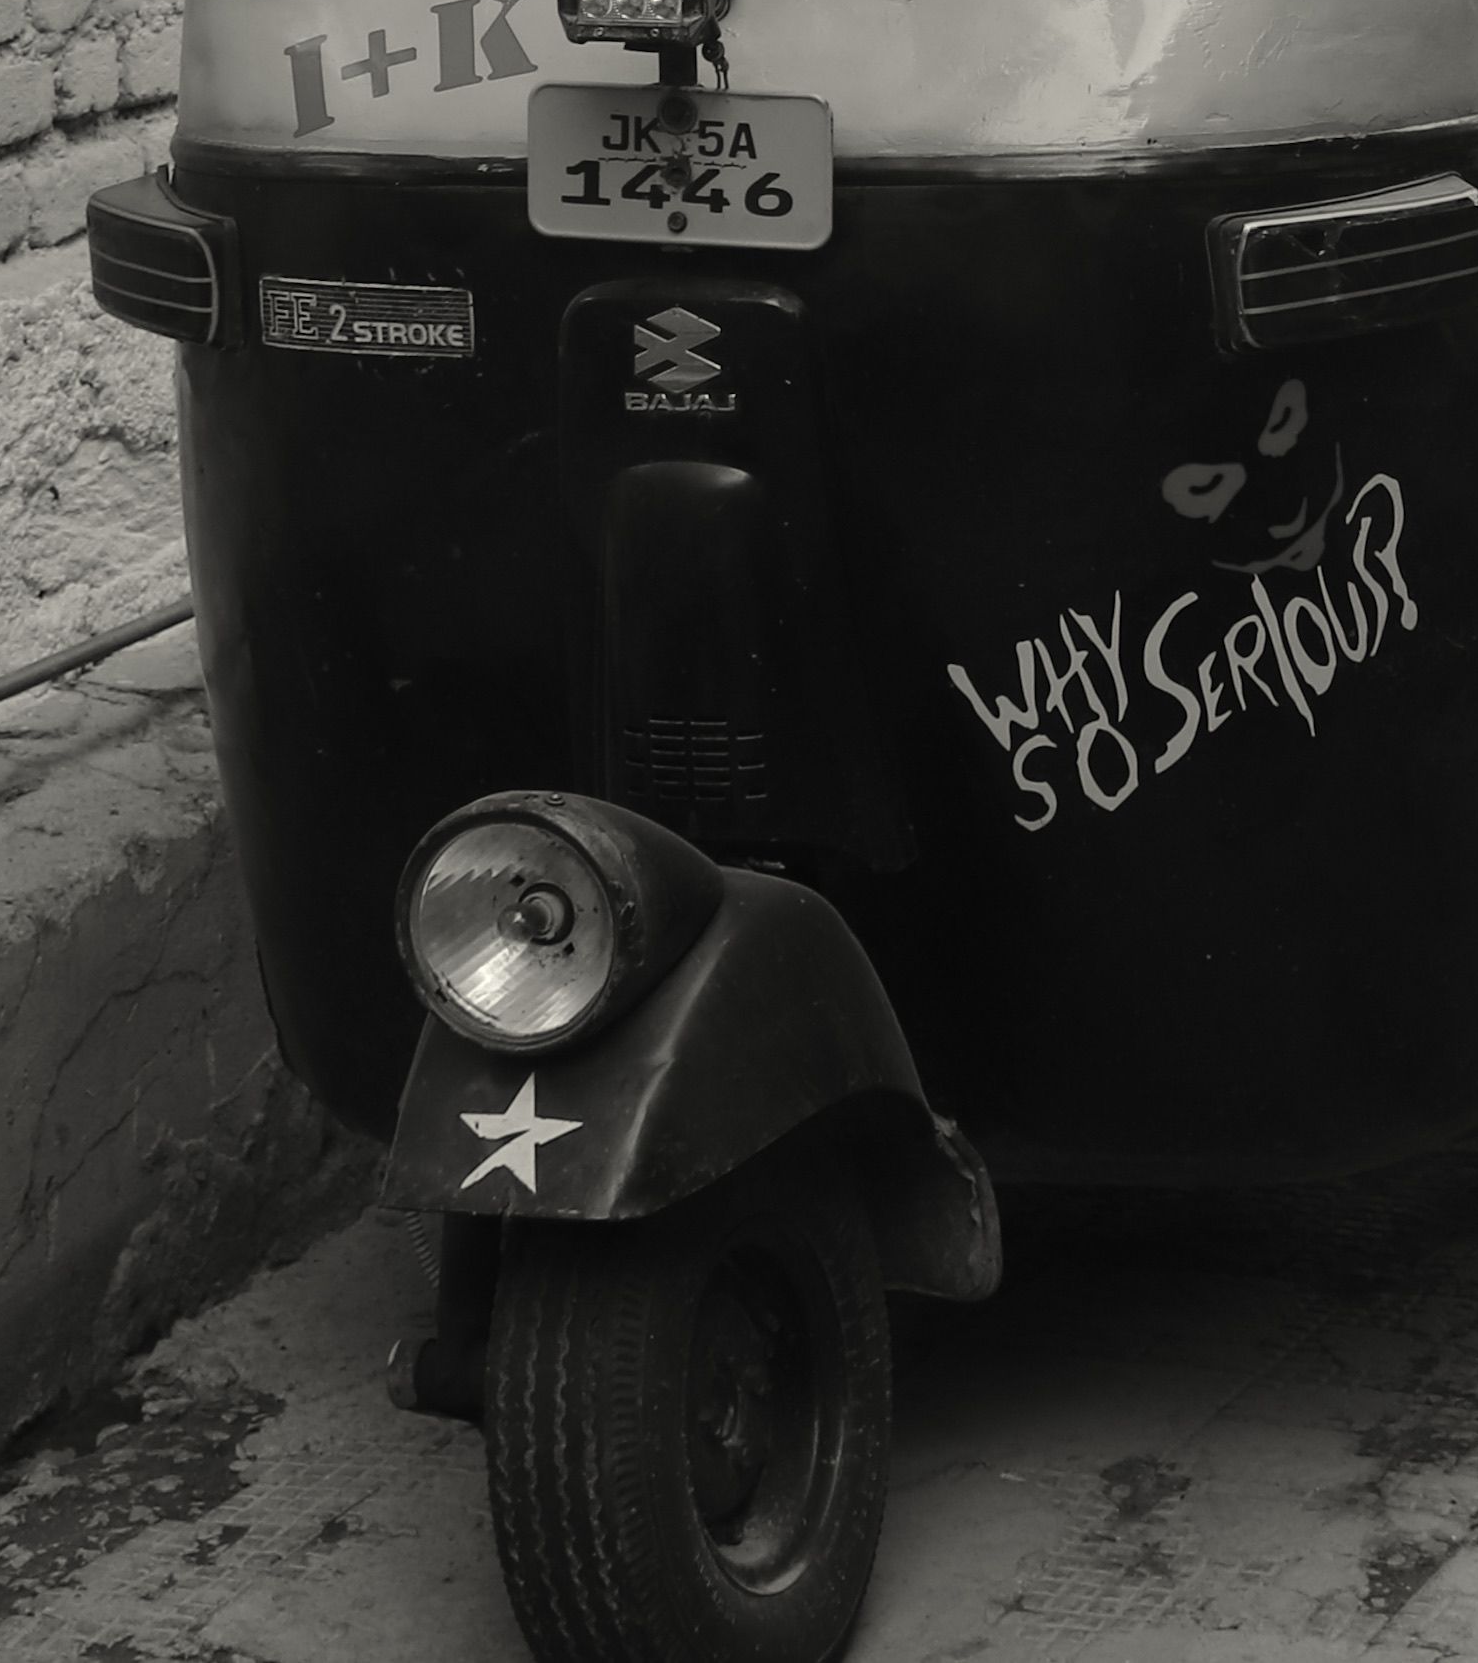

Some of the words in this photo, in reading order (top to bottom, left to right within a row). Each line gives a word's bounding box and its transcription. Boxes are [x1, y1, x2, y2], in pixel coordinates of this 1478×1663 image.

[560, 159, 794, 217] 1446
[328, 303, 349, 343] 2
[354, 321, 465, 348] STROKE
[625, 392, 738, 413] BAJAJ
[947, 589, 1129, 751] WHY
[1013, 717, 1140, 832] SO
[1143, 473, 1419, 775] SERIOUS?
